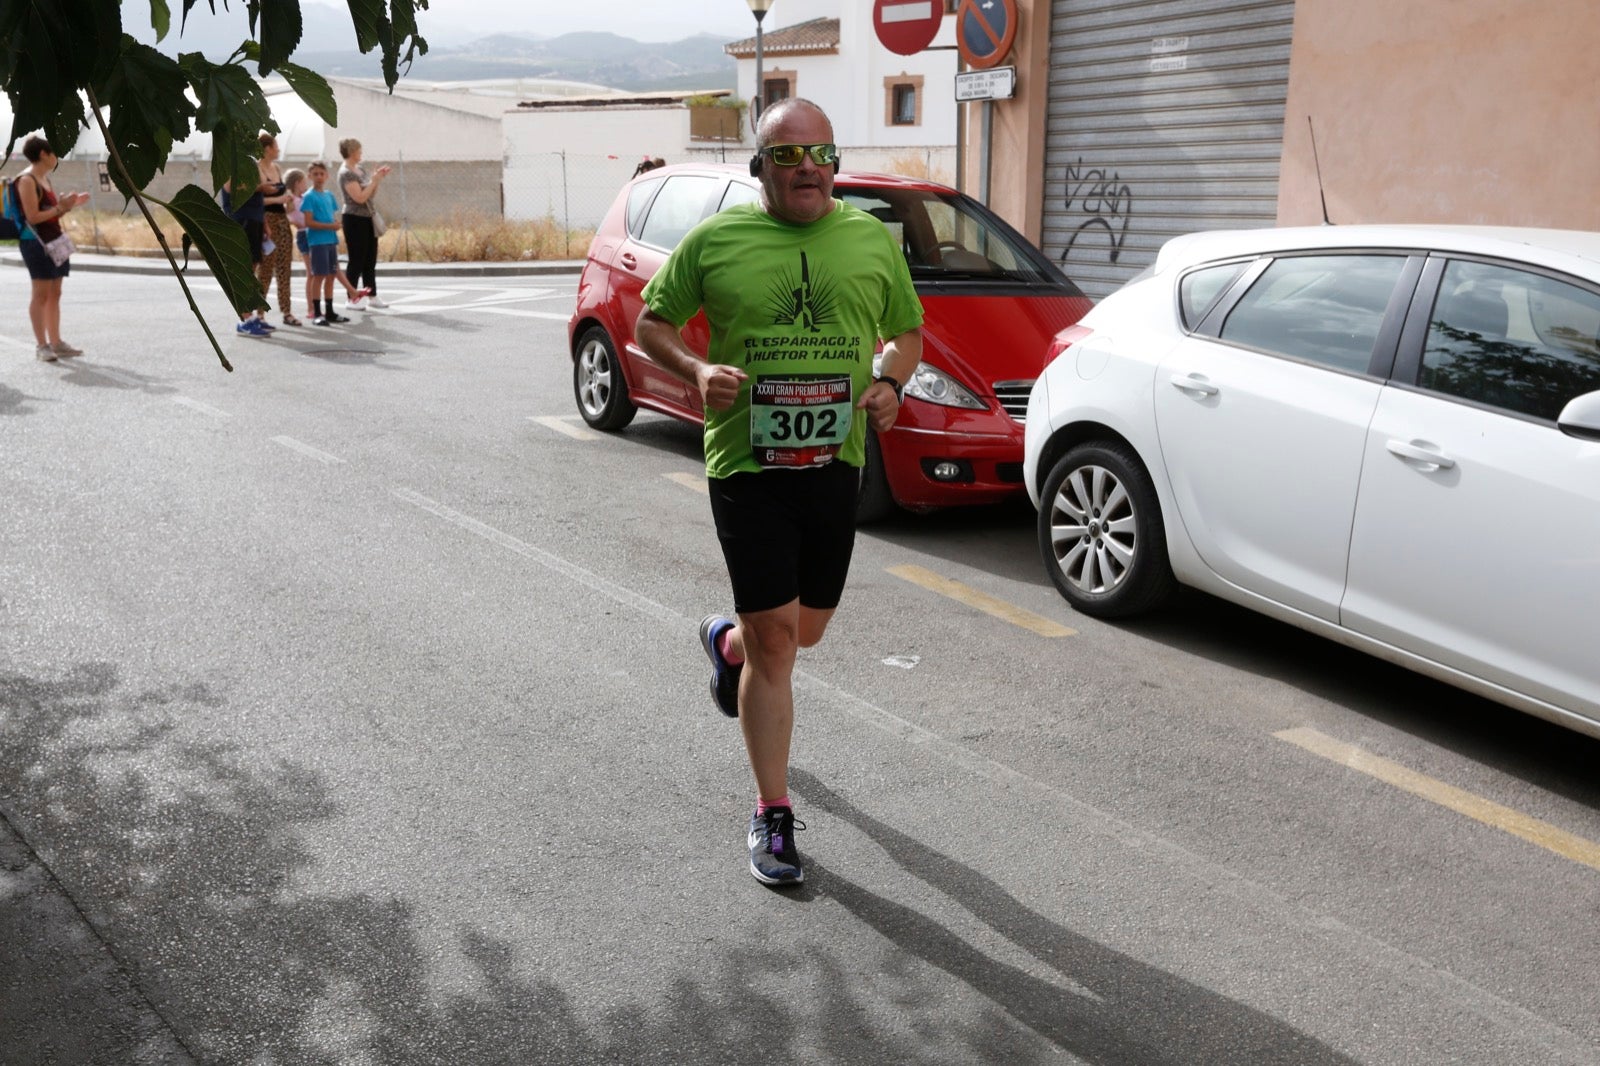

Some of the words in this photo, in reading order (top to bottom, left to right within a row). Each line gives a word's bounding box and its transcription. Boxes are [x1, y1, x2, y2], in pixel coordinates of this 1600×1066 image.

[744, 338, 758, 348] EL
[762, 335, 846, 347] ESPÁRRAGO
[753, 348, 809, 361] HUÉTOR
[812, 348, 854, 360] TÁJAR
[757, 384, 775, 394] XXXII
[776, 385, 794, 395] GRAN
[795, 385, 818, 396] PREMIO
[820, 384, 827, 394] DE
[828, 383, 847, 394] FONDO
[770, 409, 837, 441] 302
